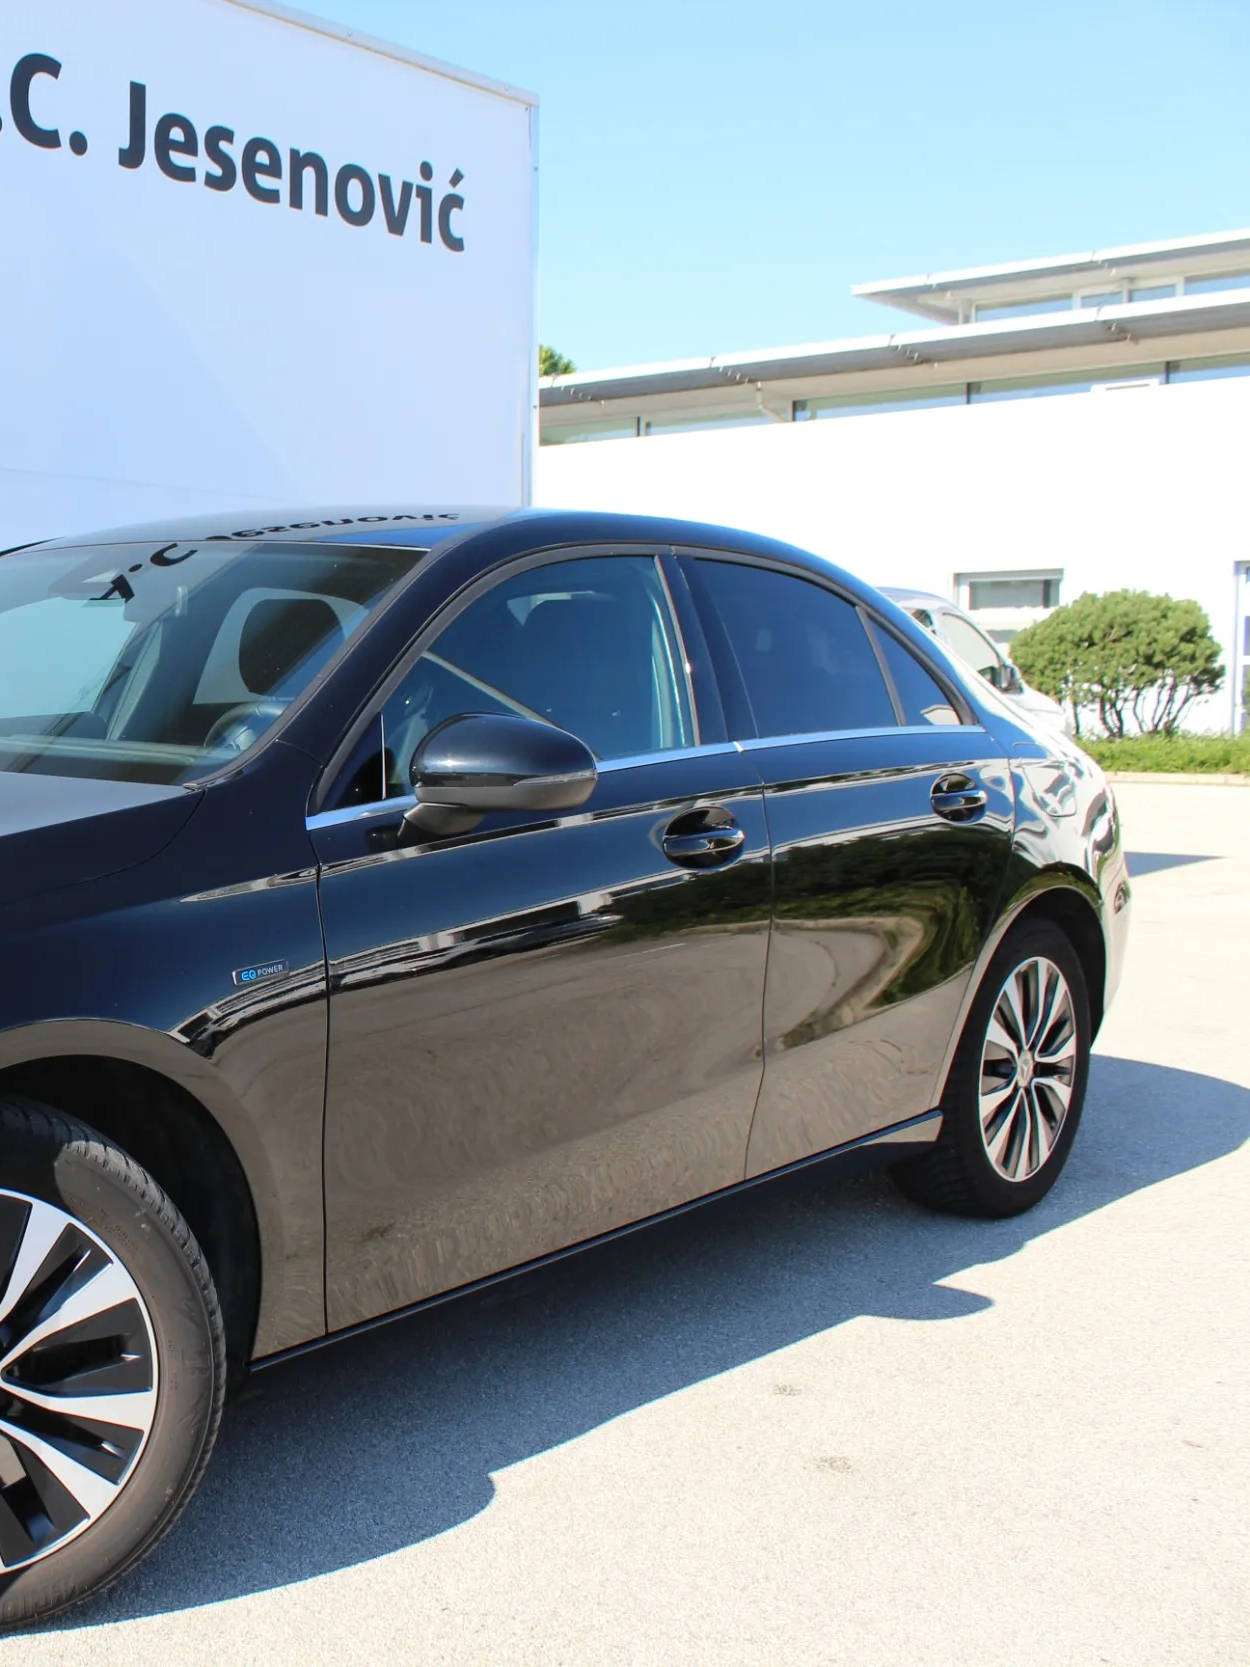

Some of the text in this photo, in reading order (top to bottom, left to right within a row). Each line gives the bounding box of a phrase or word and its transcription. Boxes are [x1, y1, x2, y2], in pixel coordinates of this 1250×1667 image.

[118, 80, 465, 252] Jesenović
[241, 964, 284, 981] EQ POWER
